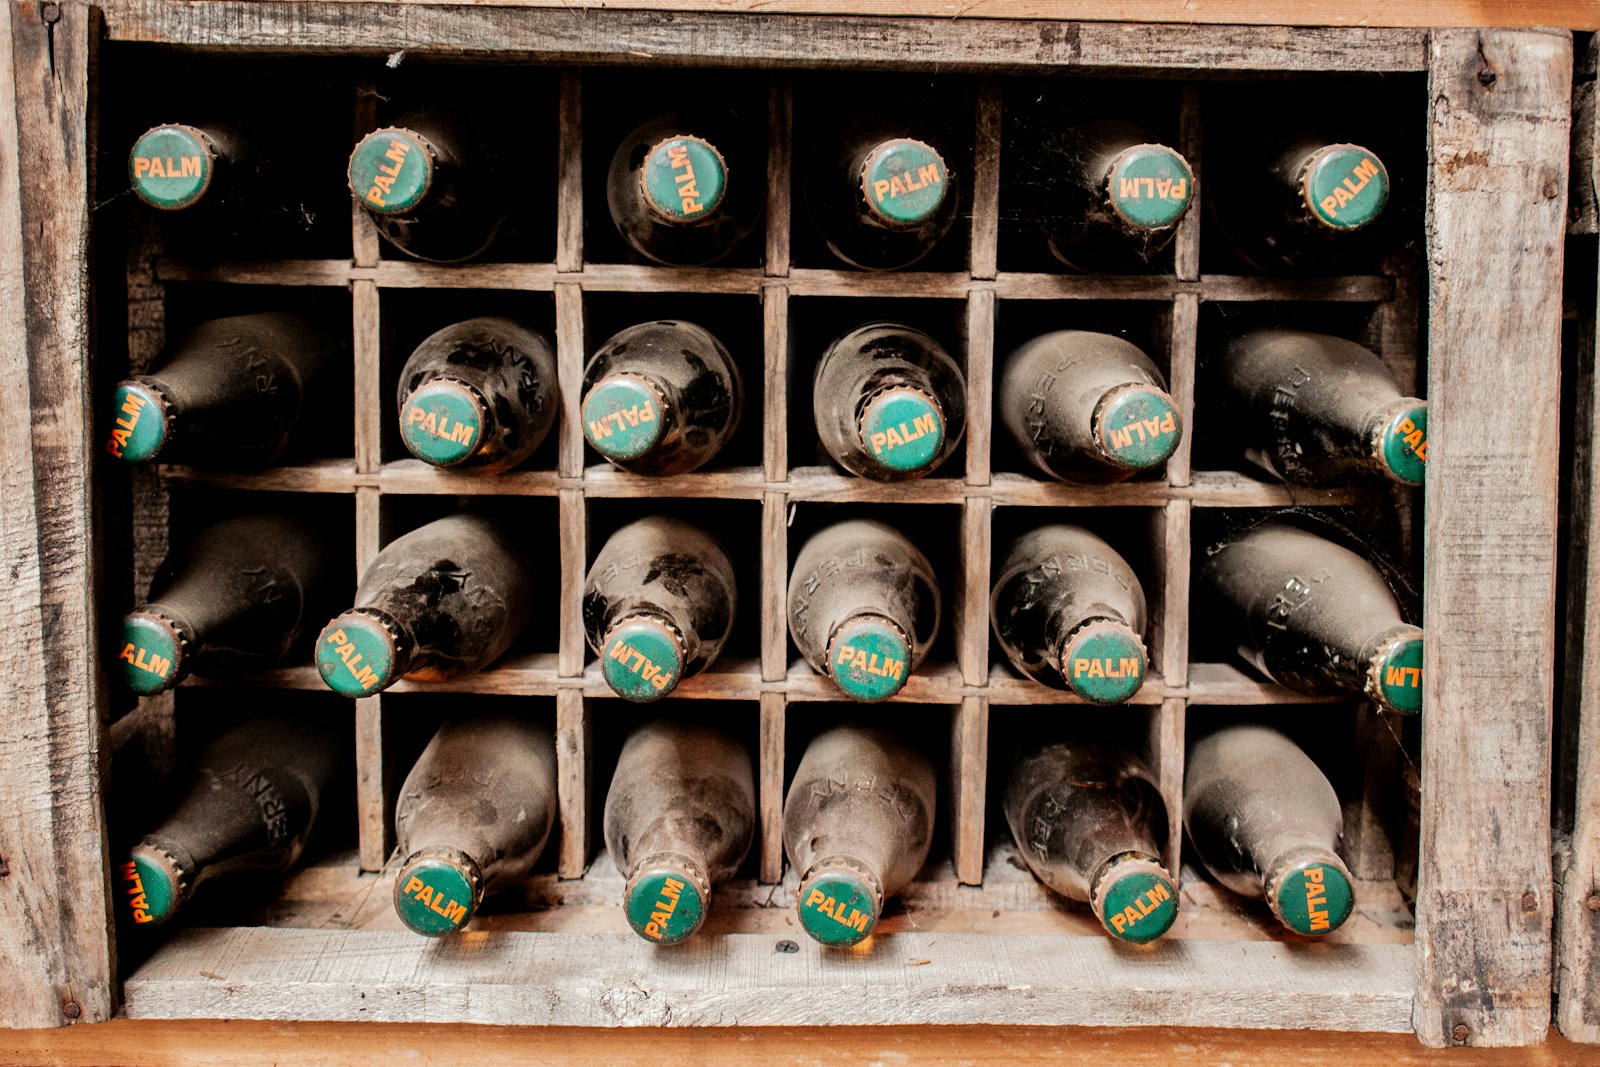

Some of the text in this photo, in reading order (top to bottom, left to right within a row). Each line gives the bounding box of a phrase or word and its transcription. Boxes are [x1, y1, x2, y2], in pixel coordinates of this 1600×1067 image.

[133, 156, 201, 178] PALM
[366, 139, 411, 208] PALM
[666, 145, 705, 215] PALM
[873, 162, 942, 203] PALM
[1119, 177, 1186, 199] PALM
[1319, 157, 1379, 219] PALM
[106, 393, 146, 459] PALM
[406, 406, 474, 446] PALM
[588, 399, 655, 441] PALM
[869, 412, 938, 454] PALM
[1109, 411, 1176, 449] PALM
[1394, 416, 1427, 462] PAL
[118, 642, 171, 678] ALM
[326, 627, 380, 691] PALM
[608, 639, 673, 691] PALM
[836, 645, 904, 680] PALM
[1073, 657, 1139, 678] PALM
[1385, 665, 1423, 688] LM
[118, 859, 154, 924] PALM
[402, 874, 468, 925] PALM
[643, 877, 686, 940] PALM
[806, 887, 873, 933] PALM
[1110, 883, 1171, 935] PALM
[1302, 867, 1330, 932] PALM
